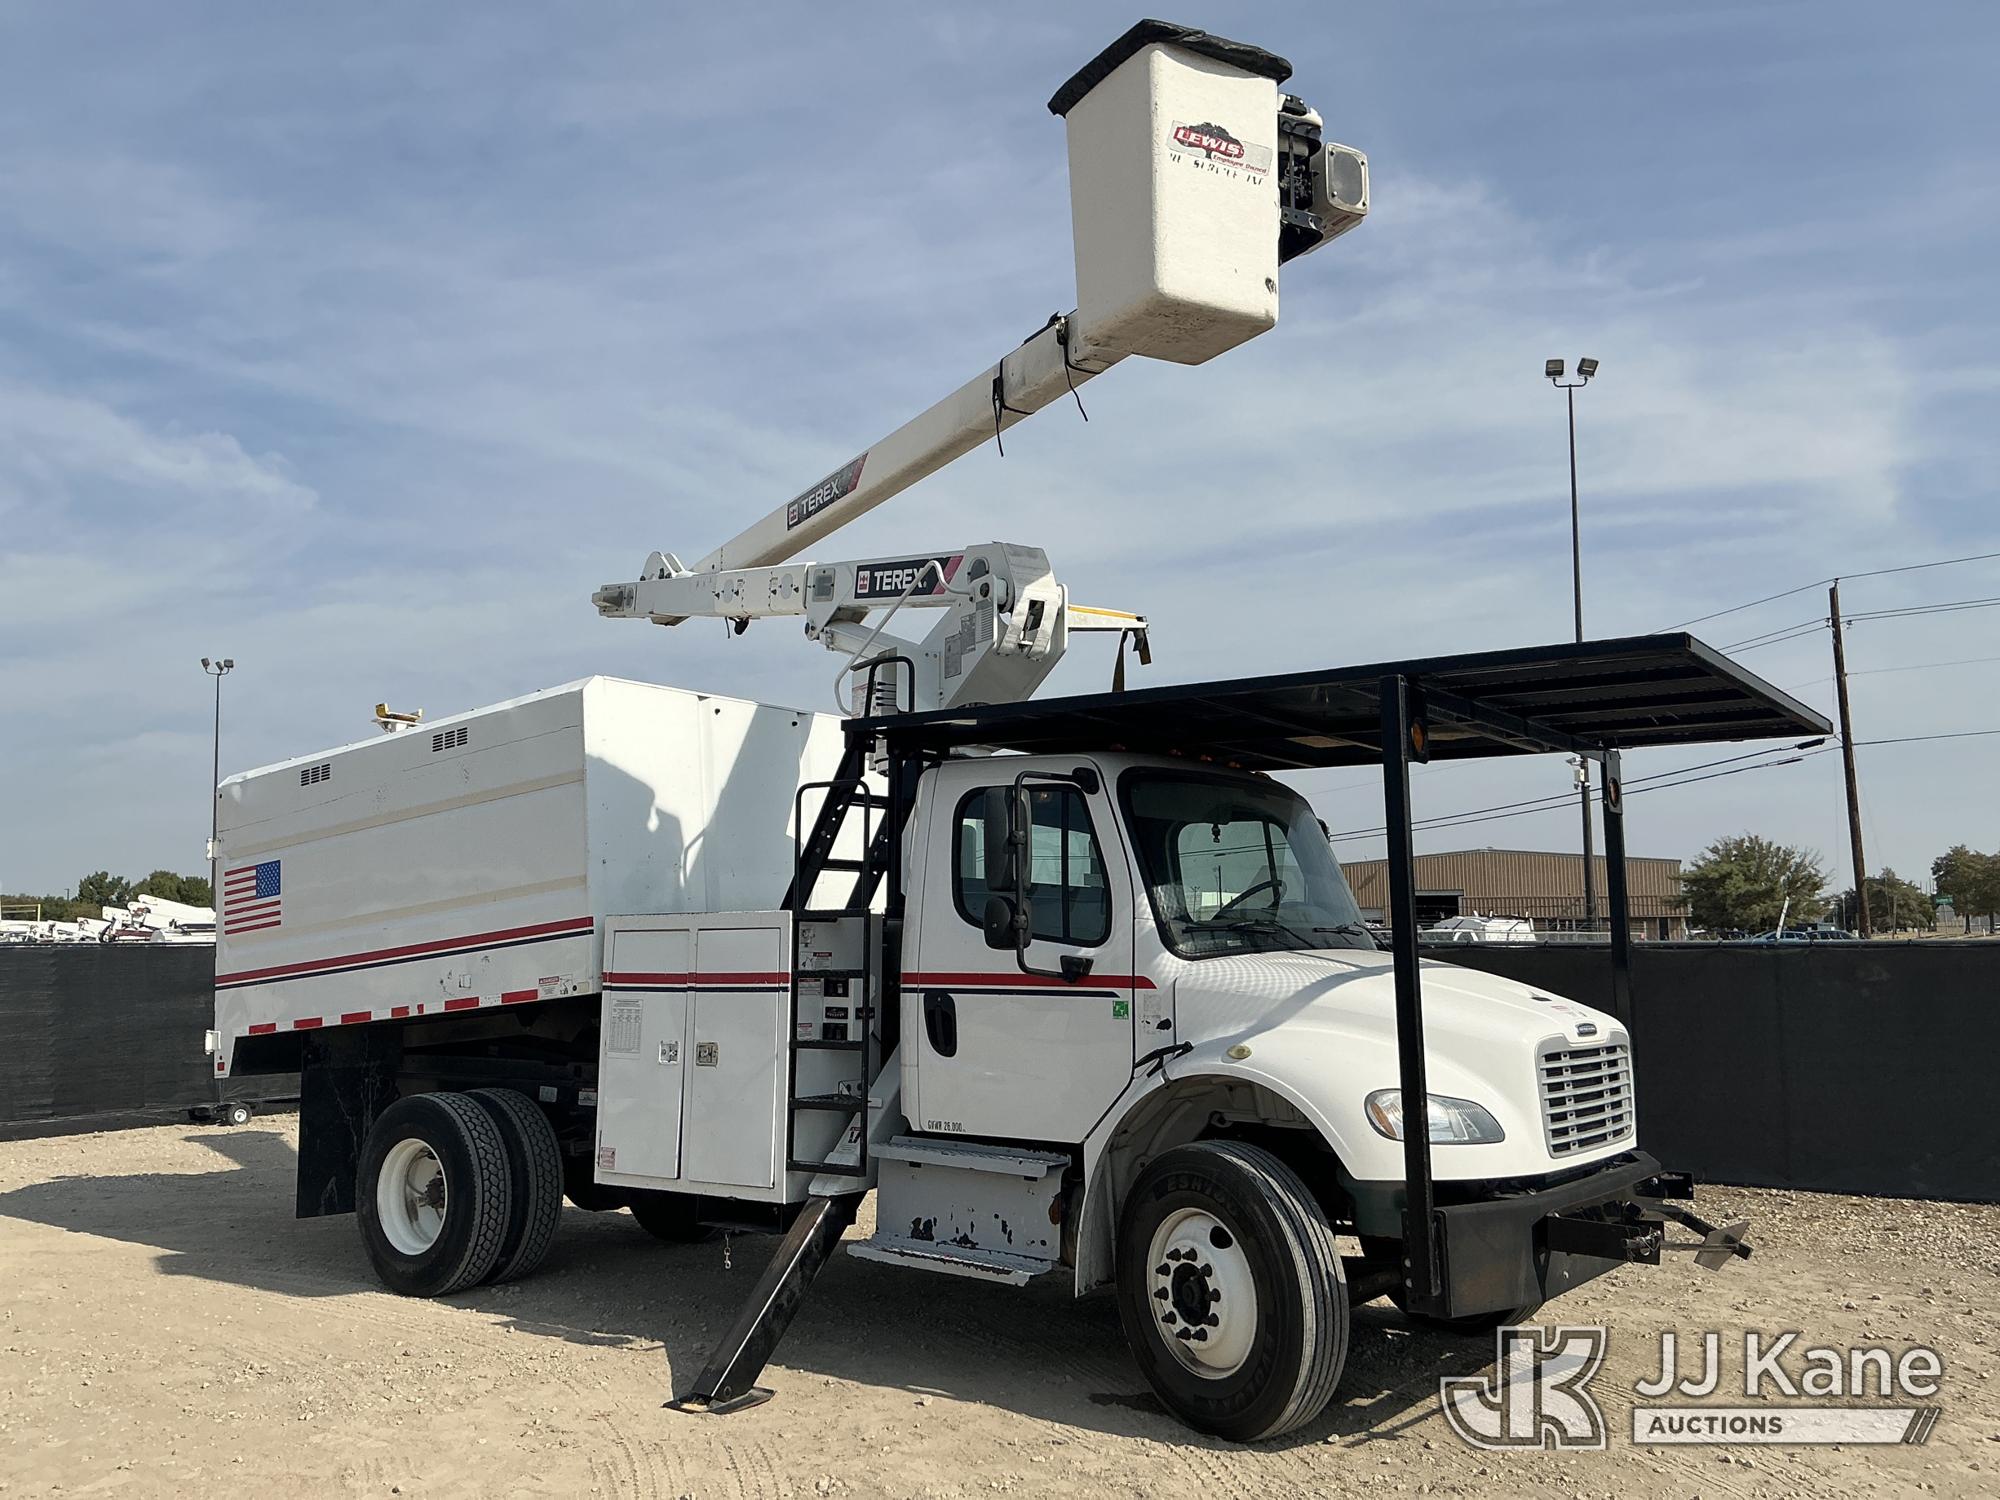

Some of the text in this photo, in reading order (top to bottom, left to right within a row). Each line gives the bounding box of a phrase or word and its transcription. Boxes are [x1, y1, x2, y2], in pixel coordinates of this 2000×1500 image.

[1176, 128, 1242, 156] LEWIS
[1213, 155, 1244, 168] Employee
[801, 479, 839, 515] TEREX
